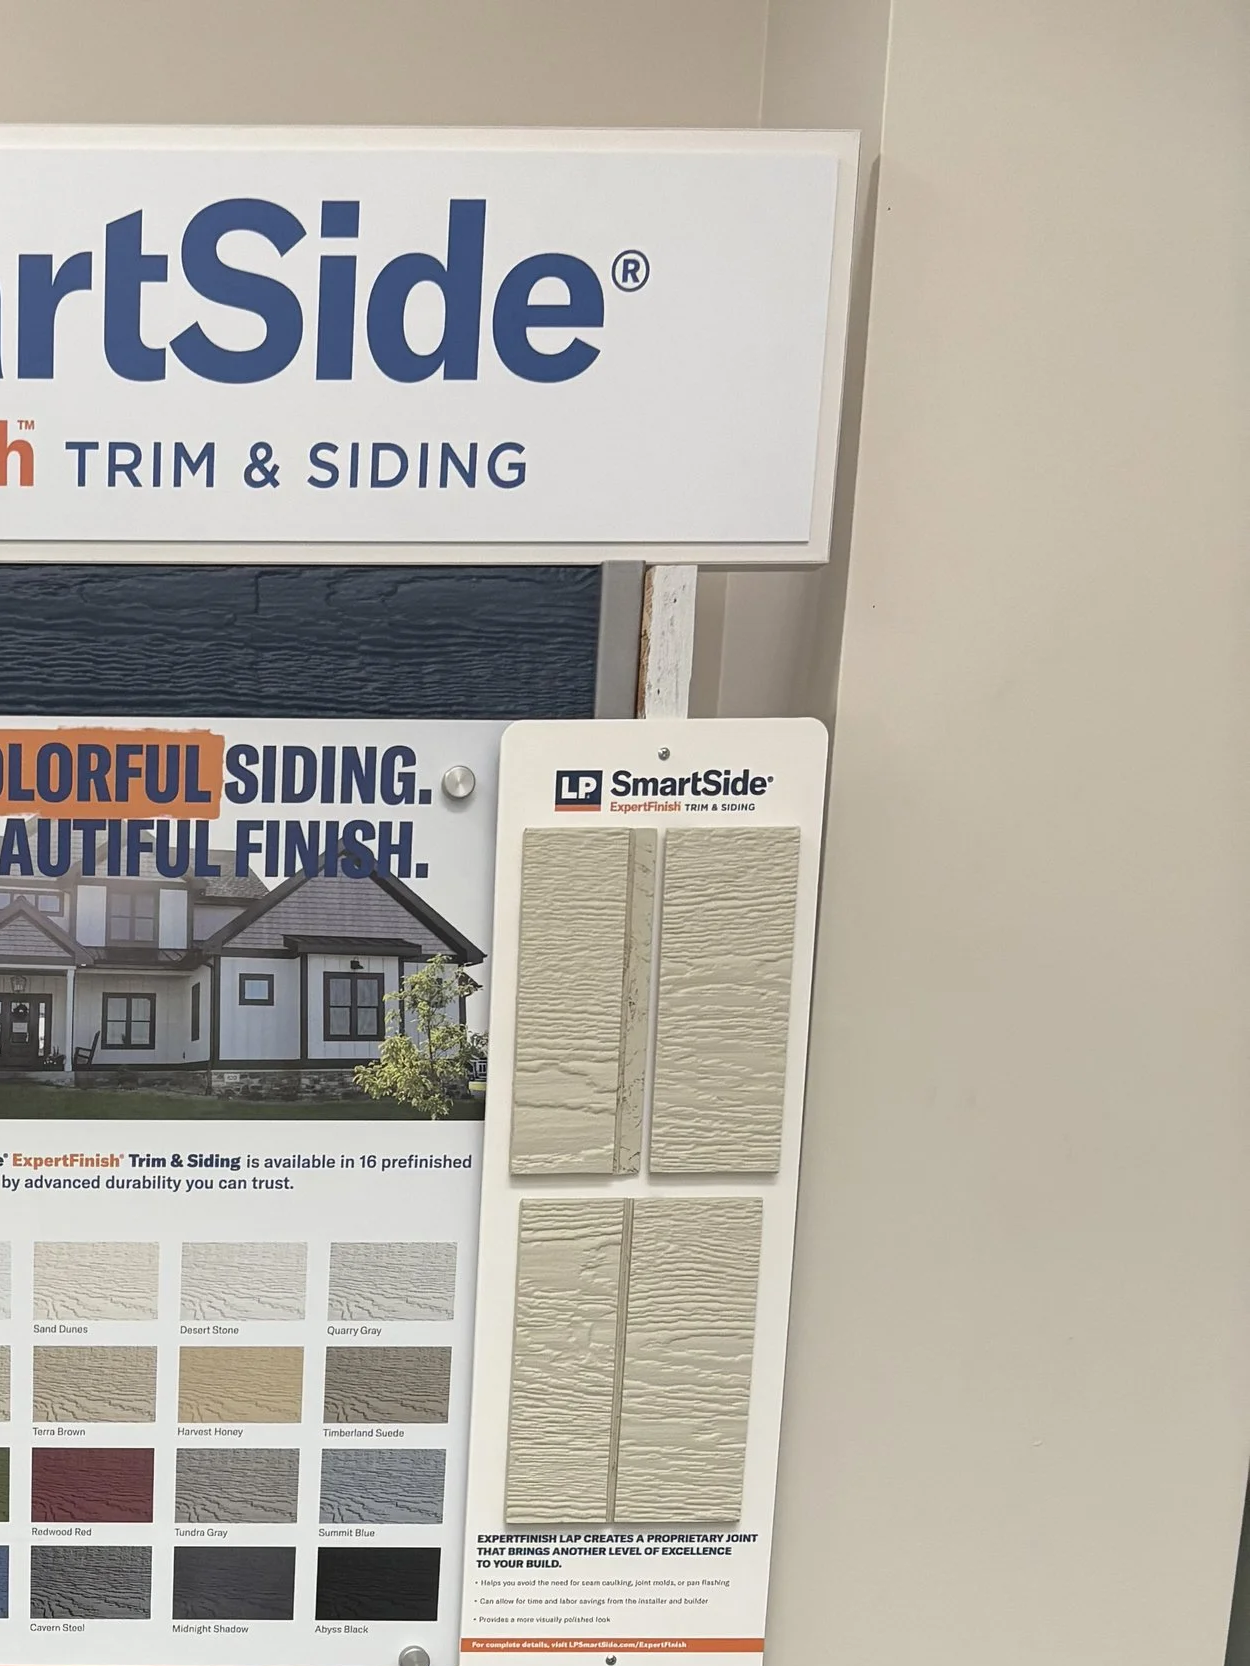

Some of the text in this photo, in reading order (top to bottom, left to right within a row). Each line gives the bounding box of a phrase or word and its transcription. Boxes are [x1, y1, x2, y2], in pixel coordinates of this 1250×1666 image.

[65, 441, 216, 488] TRIM
[243, 441, 281, 488] &
[307, 441, 527, 489] SIDING
[225, 744, 432, 804] SIDING.
[684, 803, 709, 812] TRIM
[711, 803, 718, 812] &
[721, 803, 756, 812] SIDING
[236, 820, 429, 878] FINISH.
[128, 1153, 166, 1168] Trim
[170, 1153, 184, 1168] &
[186, 1153, 242, 1172] Siding
[246, 1154, 260, 1168] is
[264, 1154, 336, 1168] available
[340, 1154, 355, 1168] in
[359, 1154, 377, 1168] 16
[381, 1154, 472, 1172] prefinished
[2, 1174, 20, 1192] by
[24, 1174, 100, 1189] advanced
[105, 1175, 182, 1193] durability
[185, 1179, 214, 1193] you
[218, 1179, 247, 1190] can
[251, 1176, 294, 1190] trust.
[33, 1324, 88, 1334] Sand Dunes
[180, 1325, 239, 1335] Desert Stone
[327, 1326, 382, 1337] Quarry Gray
[177, 1427, 244, 1438] Harvest Honey
[322, 1428, 404, 1438] Timberland Suede
[31, 1527, 92, 1536] Redwood Red
[318, 1528, 375, 1537] Summit Blue
[477, 1534, 758, 1543] EXPERTFINISH LAP CREATES A PROPRIETARY JOINT
[476, 1546, 732, 1556] THAT BRINGS ANOTHER LEVEL OF EXCELLENCE
[476, 1559, 562, 1568] TO YOUR BUILD.
[172, 1624, 249, 1635] Midnight Shadow
